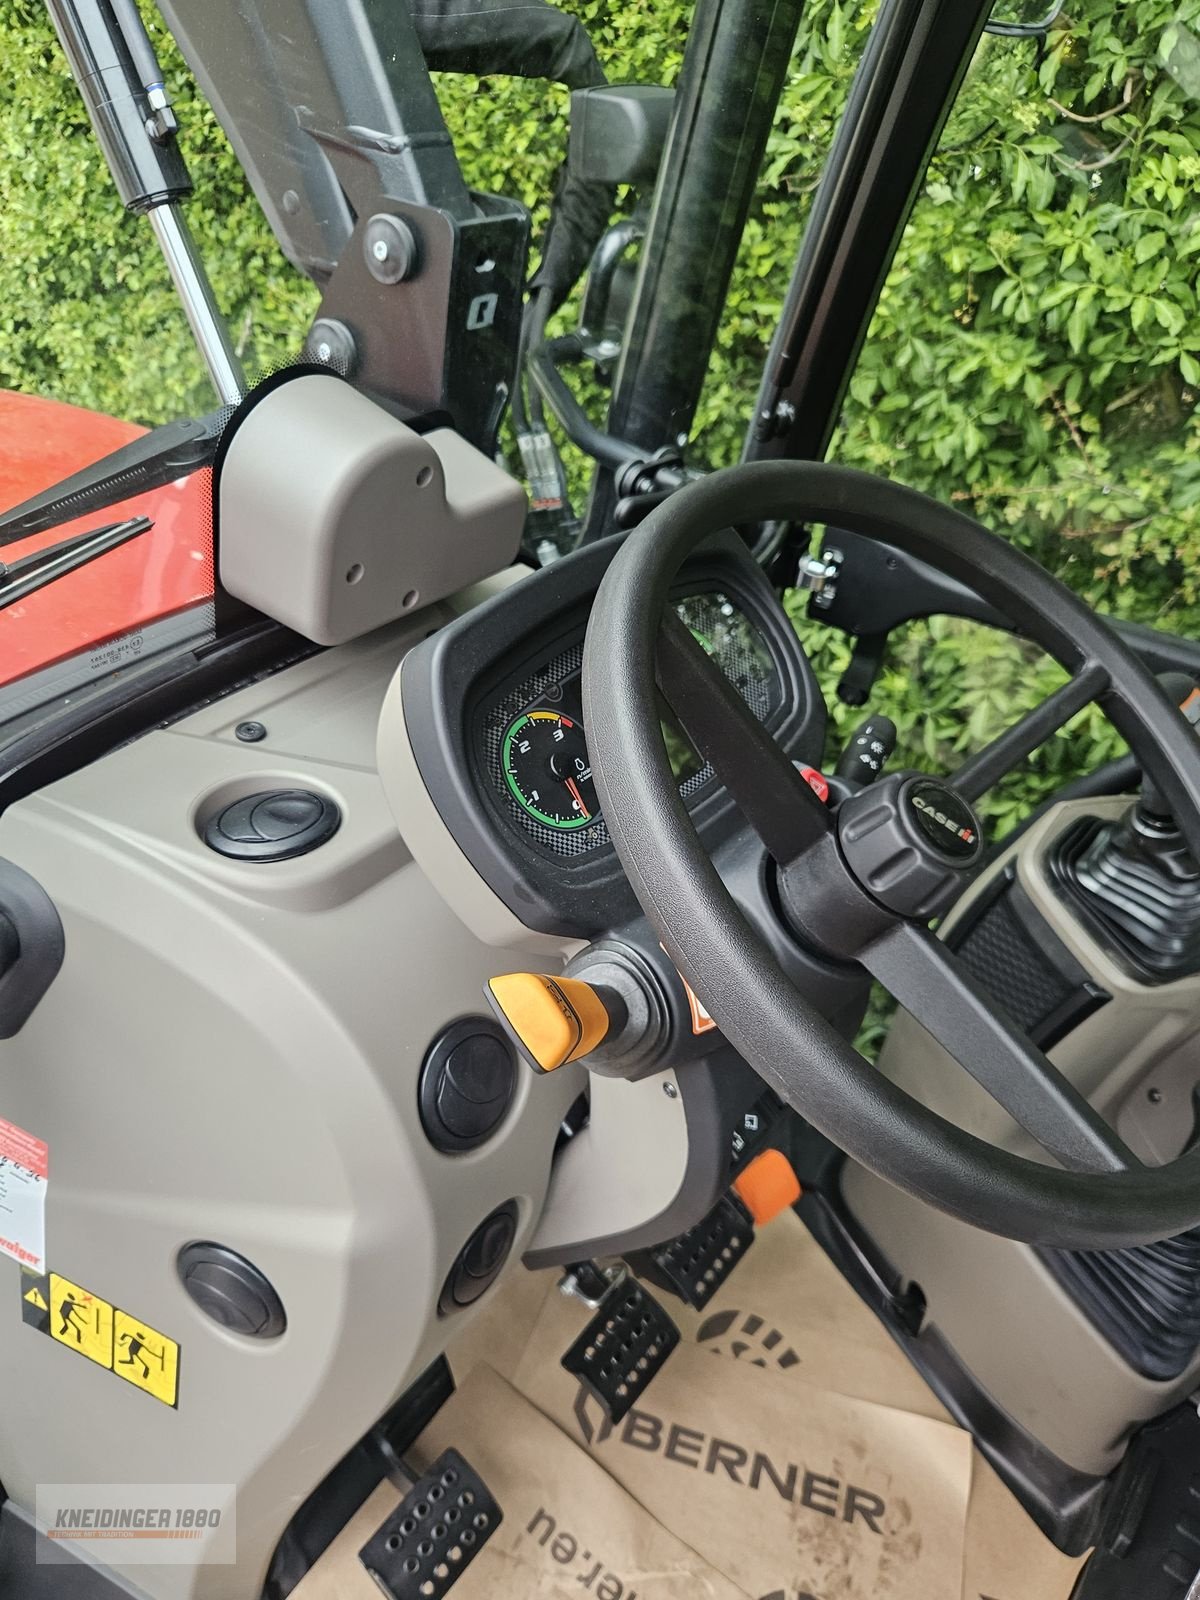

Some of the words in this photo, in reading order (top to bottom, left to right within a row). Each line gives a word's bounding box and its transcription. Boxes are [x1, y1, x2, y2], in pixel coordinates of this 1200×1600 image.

[553, 729, 564, 741] 3
[518, 740, 531, 754] 2
[532, 790, 539, 800] 1
[912, 797, 959, 832] CASE
[621, 1408, 886, 1534] BERNER
